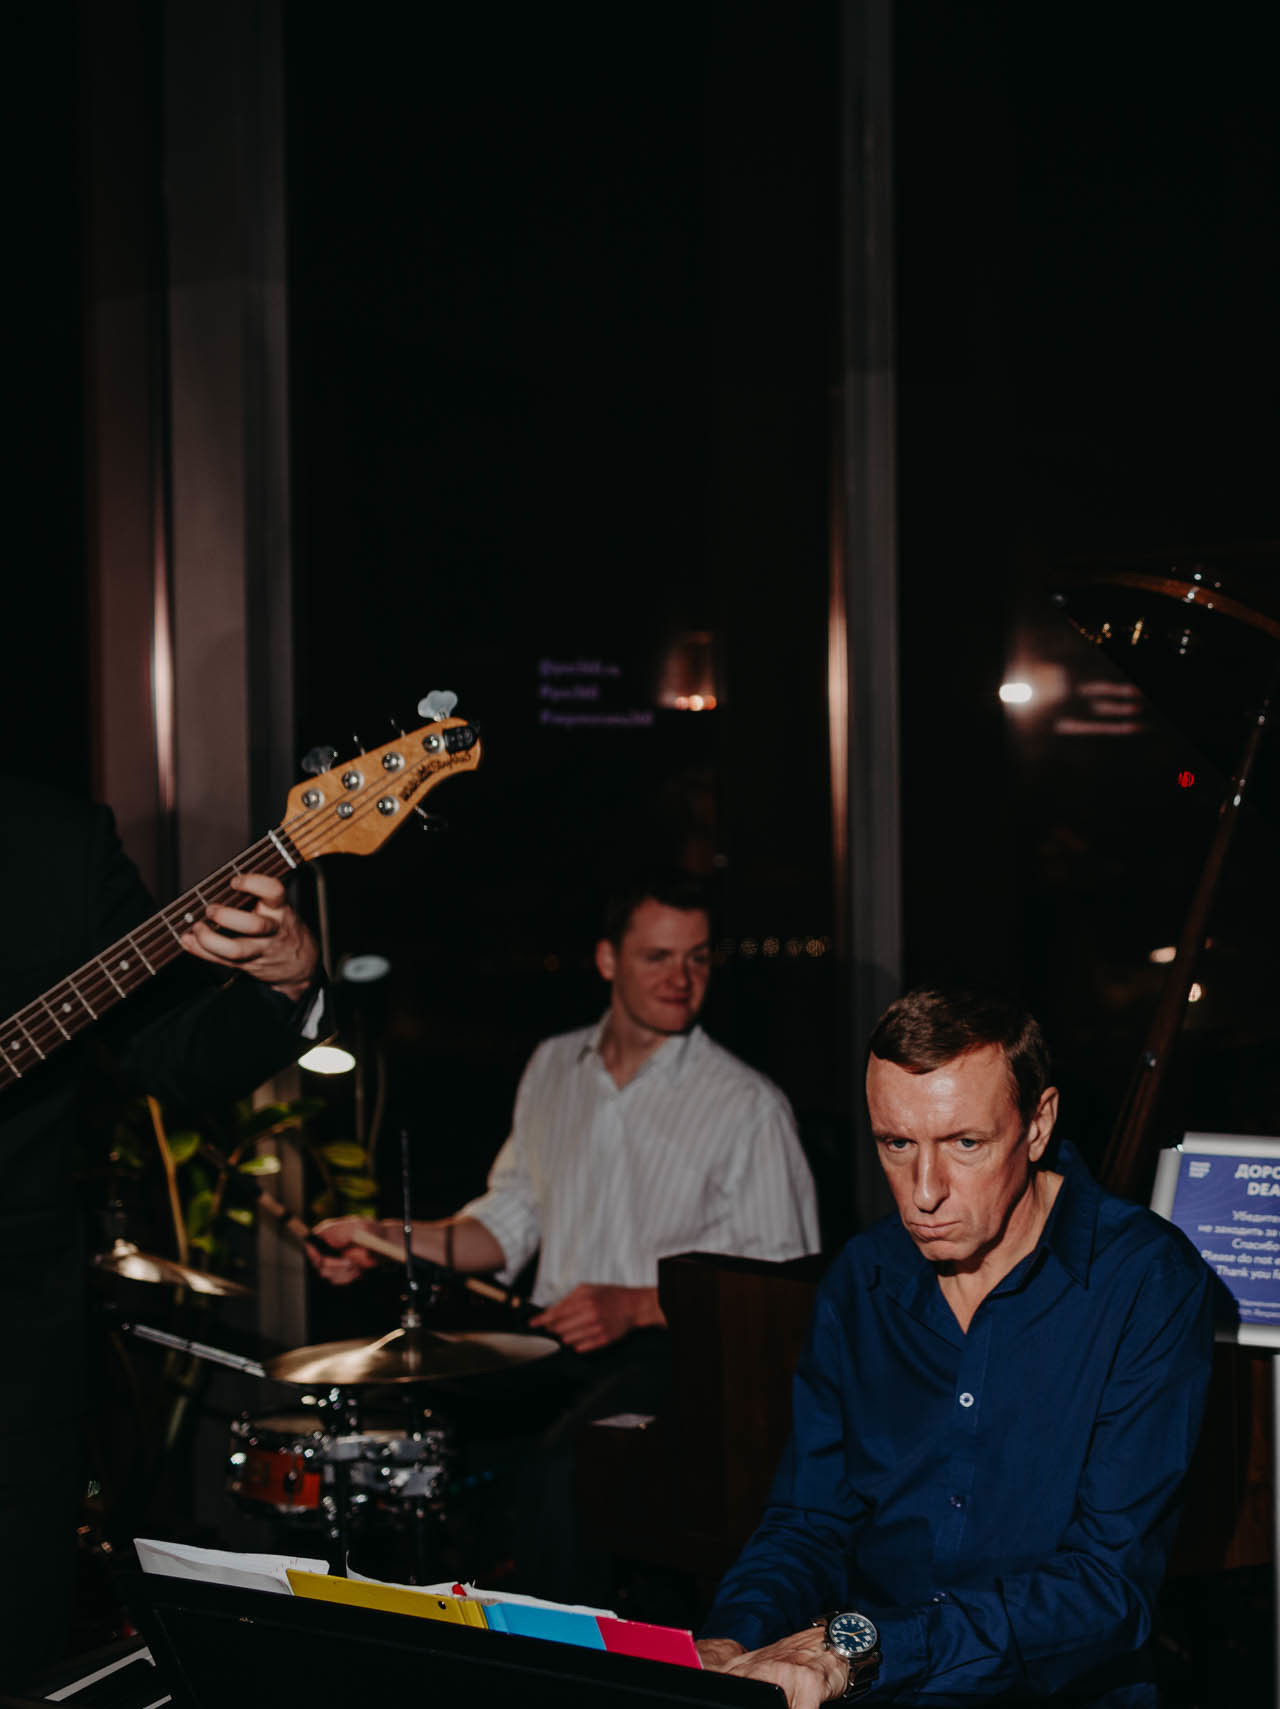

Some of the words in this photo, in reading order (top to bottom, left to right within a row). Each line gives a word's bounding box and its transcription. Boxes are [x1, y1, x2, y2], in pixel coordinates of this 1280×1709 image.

[1265, 1229, 1278, 1238] за
[1231, 1238, 1280, 1252] Спасибо
[1201, 1249, 1236, 1263] Please
[1237, 1253, 1252, 1264] do
[1253, 1256, 1273, 1265] not
[1216, 1264, 1249, 1277] Thank
[1250, 1270, 1272, 1281] you
